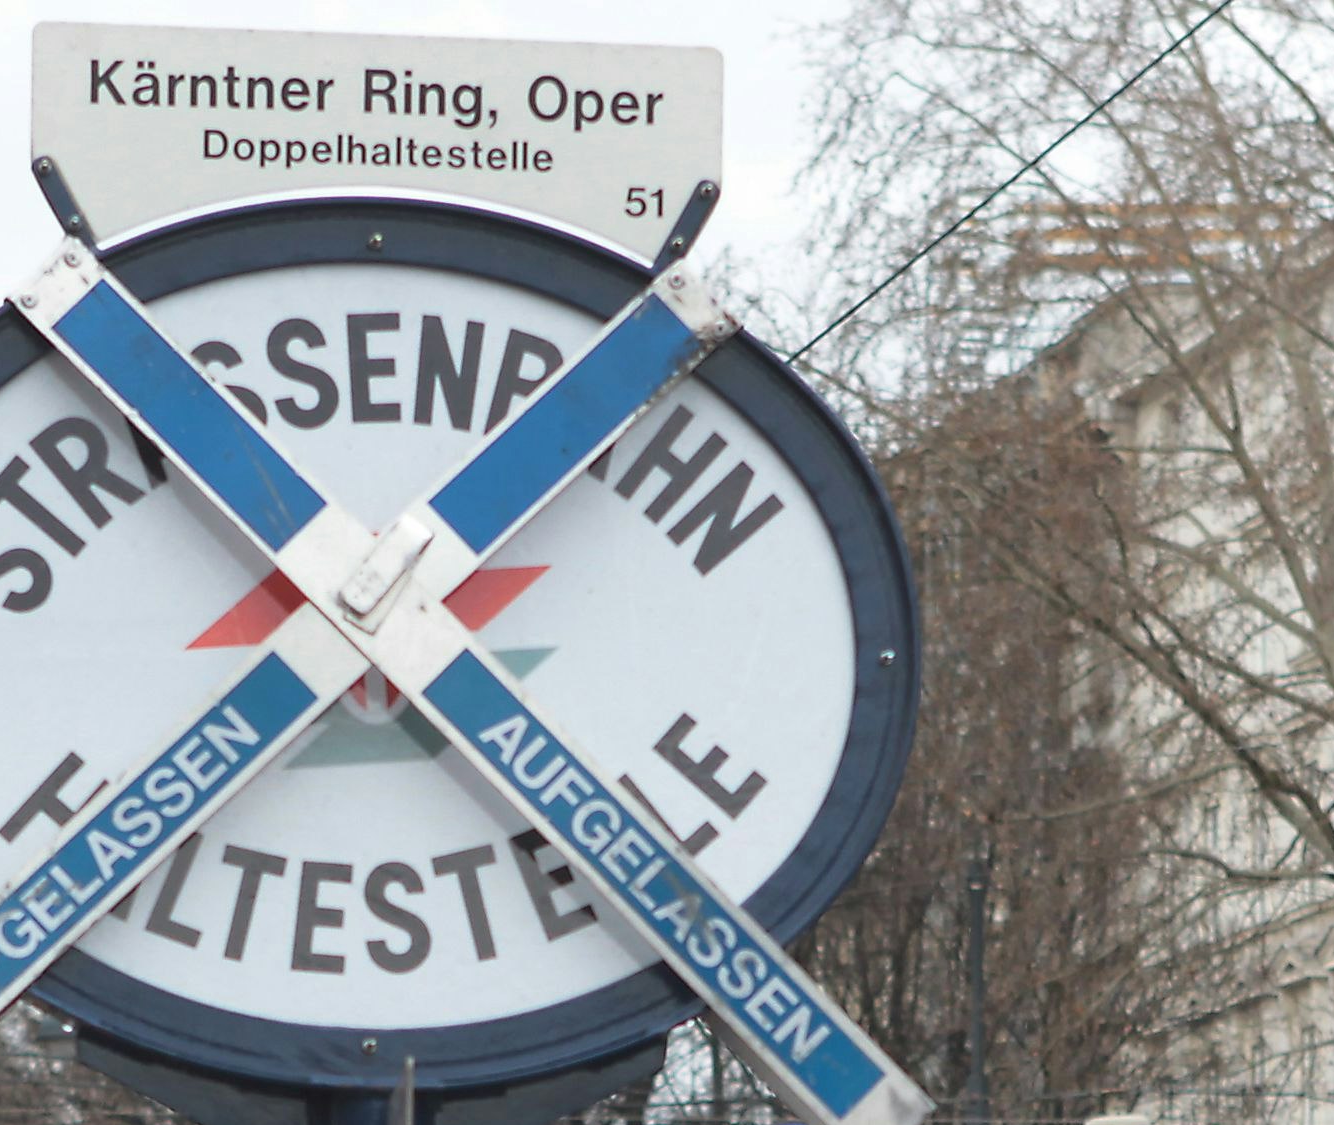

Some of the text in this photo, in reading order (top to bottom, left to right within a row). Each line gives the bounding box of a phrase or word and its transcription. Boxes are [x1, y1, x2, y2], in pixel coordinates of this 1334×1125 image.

[89, 58, 665, 131] Kärntner Ring, Oper
[202, 129, 554, 172] Doppelhaltestelle
[624, 188, 666, 218] 51
[478, 714, 831, 1072] AUFGELASSEN
